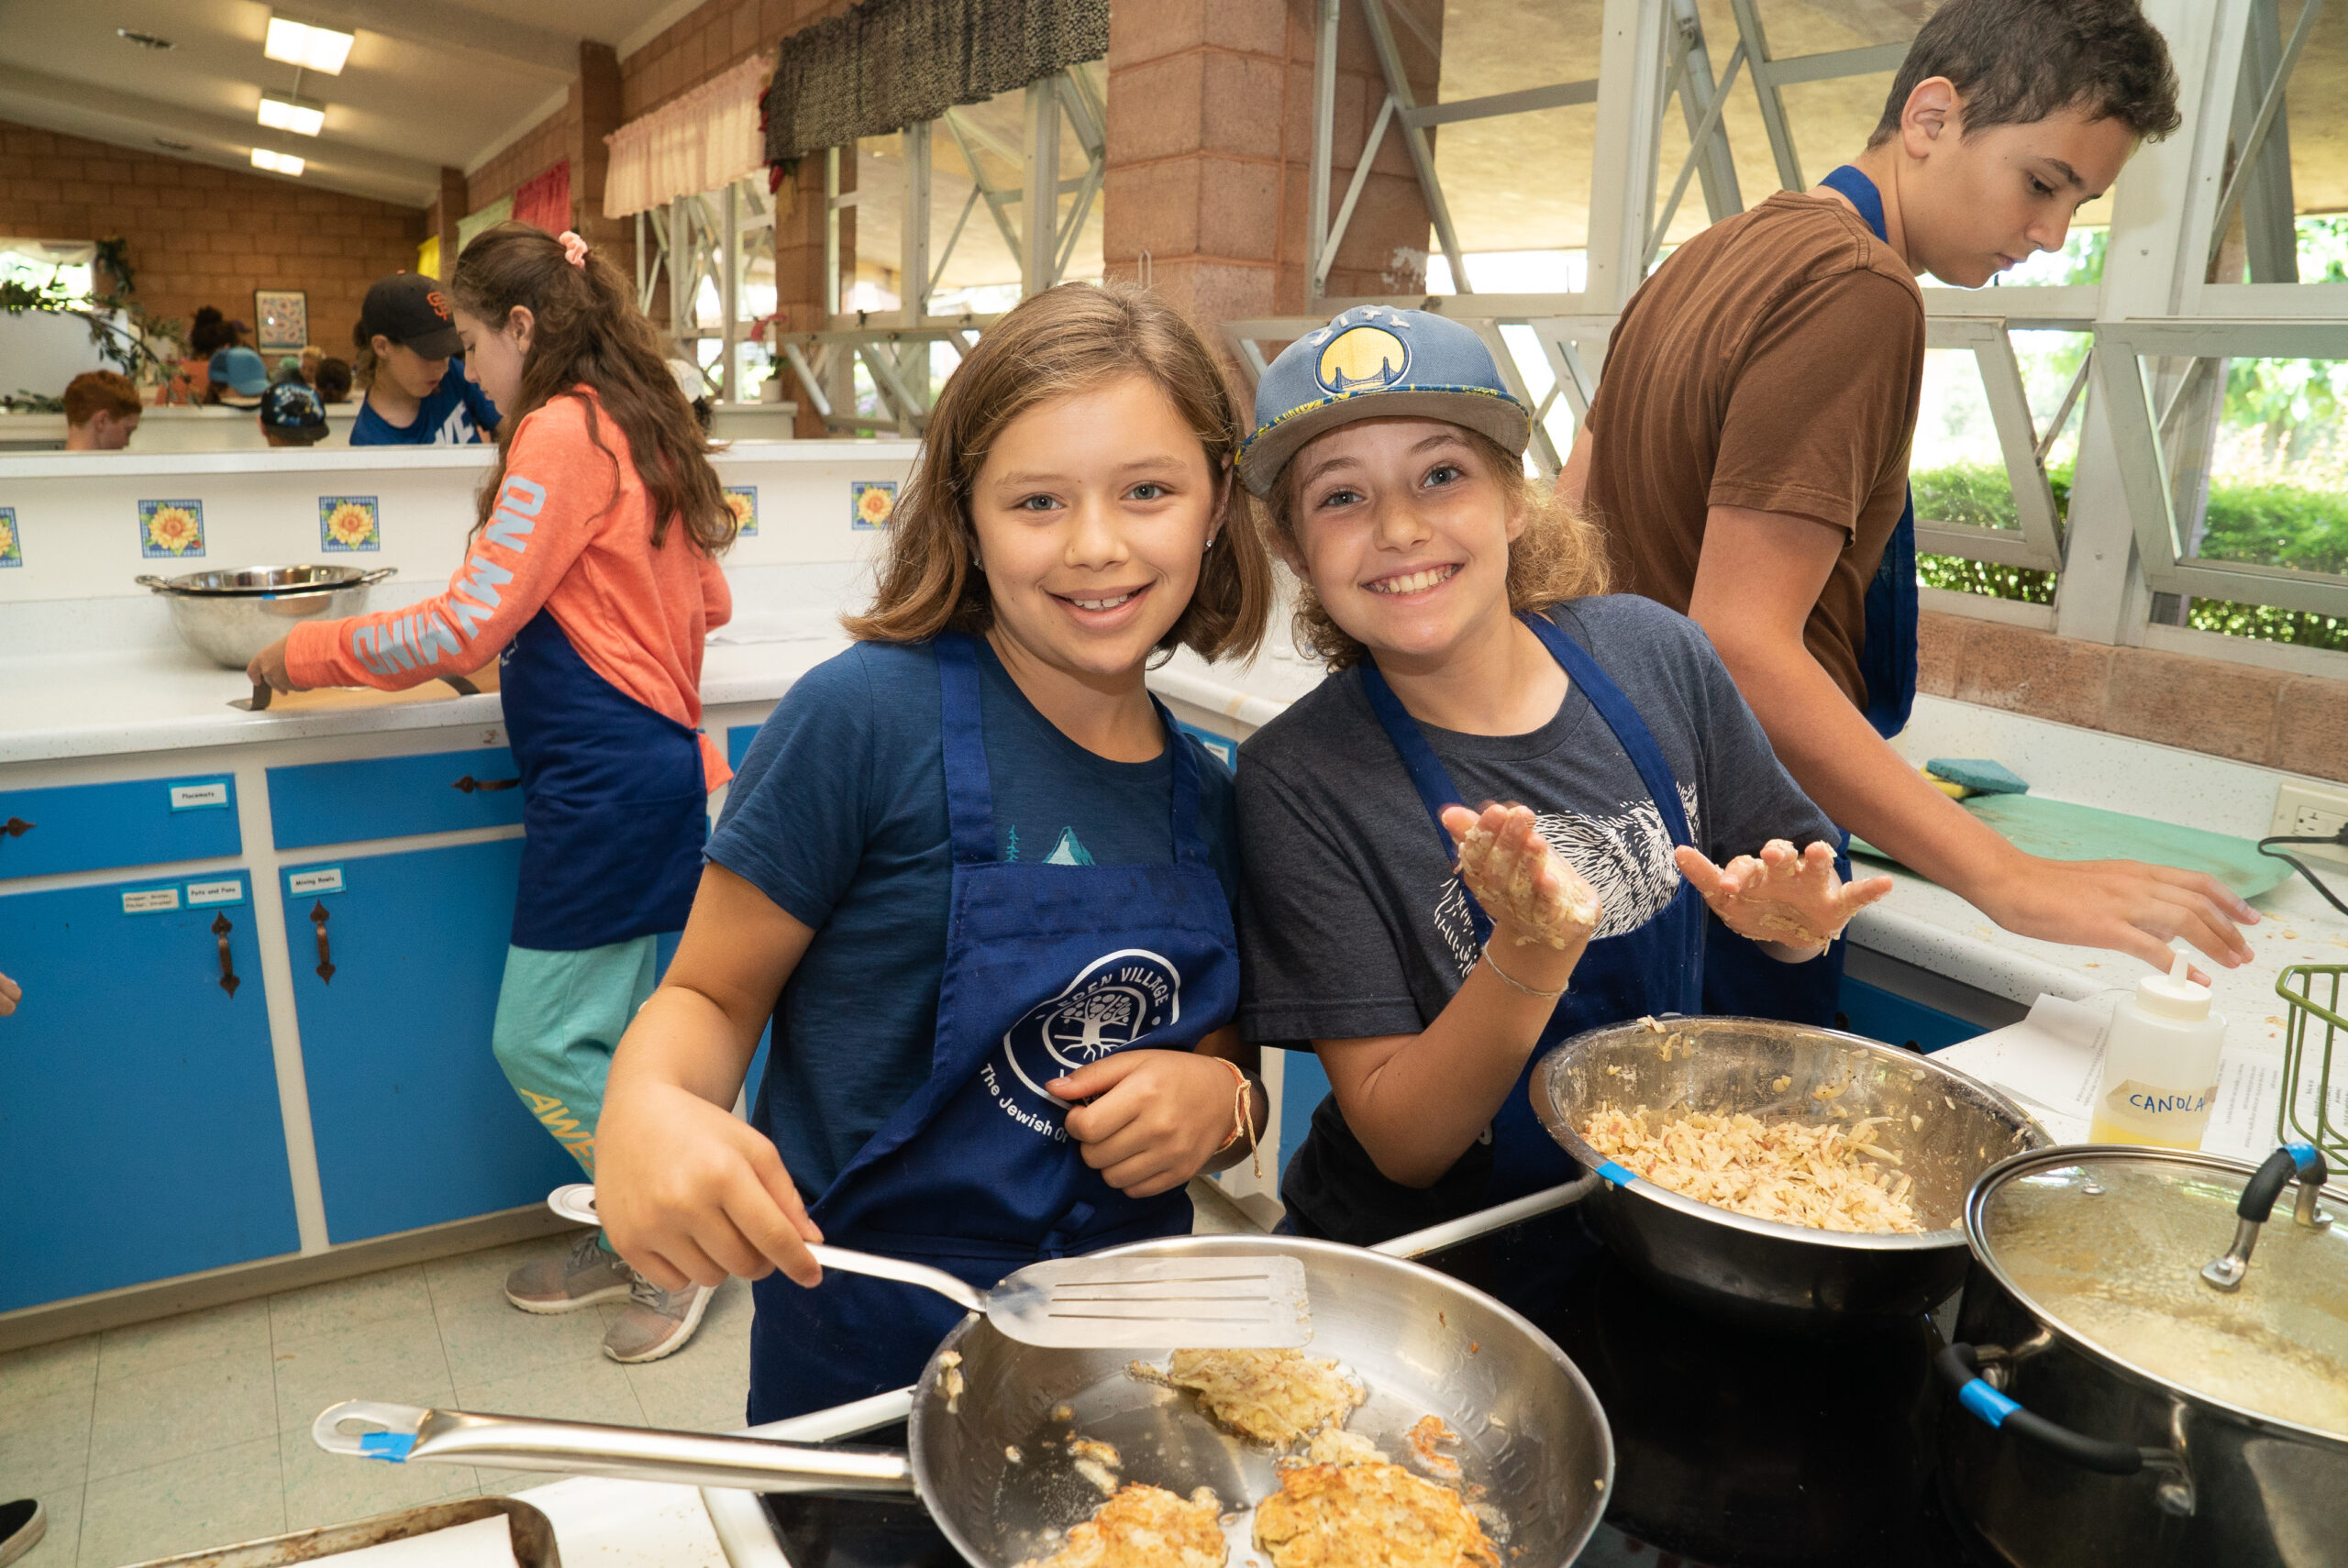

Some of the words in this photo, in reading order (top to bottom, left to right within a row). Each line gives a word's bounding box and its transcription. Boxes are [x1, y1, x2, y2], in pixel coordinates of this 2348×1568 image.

[485, 475, 547, 554] ON
[449, 555, 514, 640] MY
[352, 611, 461, 676] MIND
[1120, 966, 1169, 1007] VILLAGE
[980, 1063, 1001, 1097] The
[999, 1098, 1053, 1136] Jewish
[2129, 1094, 2204, 1114] CANOLA
